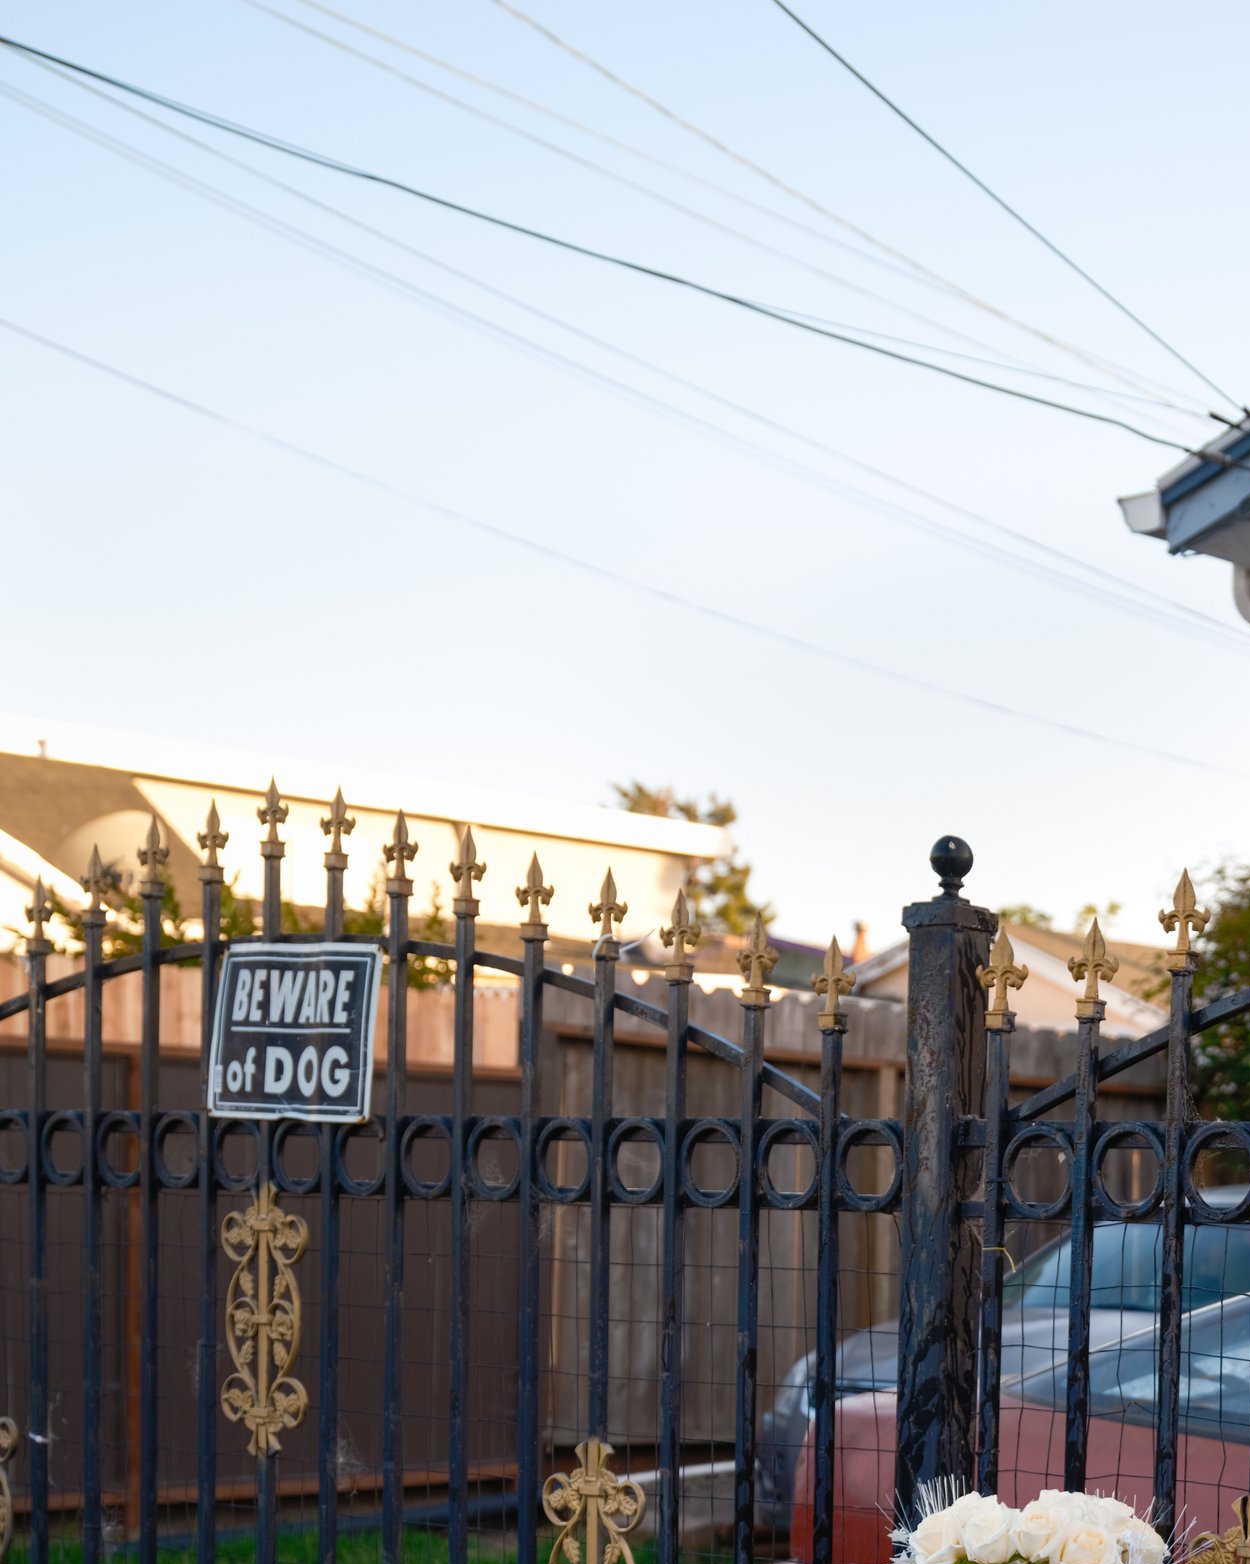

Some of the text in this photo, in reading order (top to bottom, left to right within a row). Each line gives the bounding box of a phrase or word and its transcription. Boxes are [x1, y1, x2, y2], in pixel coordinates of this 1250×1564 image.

[231, 968, 355, 1024] BEWARE
[226, 1046, 256, 1093] of
[264, 1045, 350, 1098] DOG
